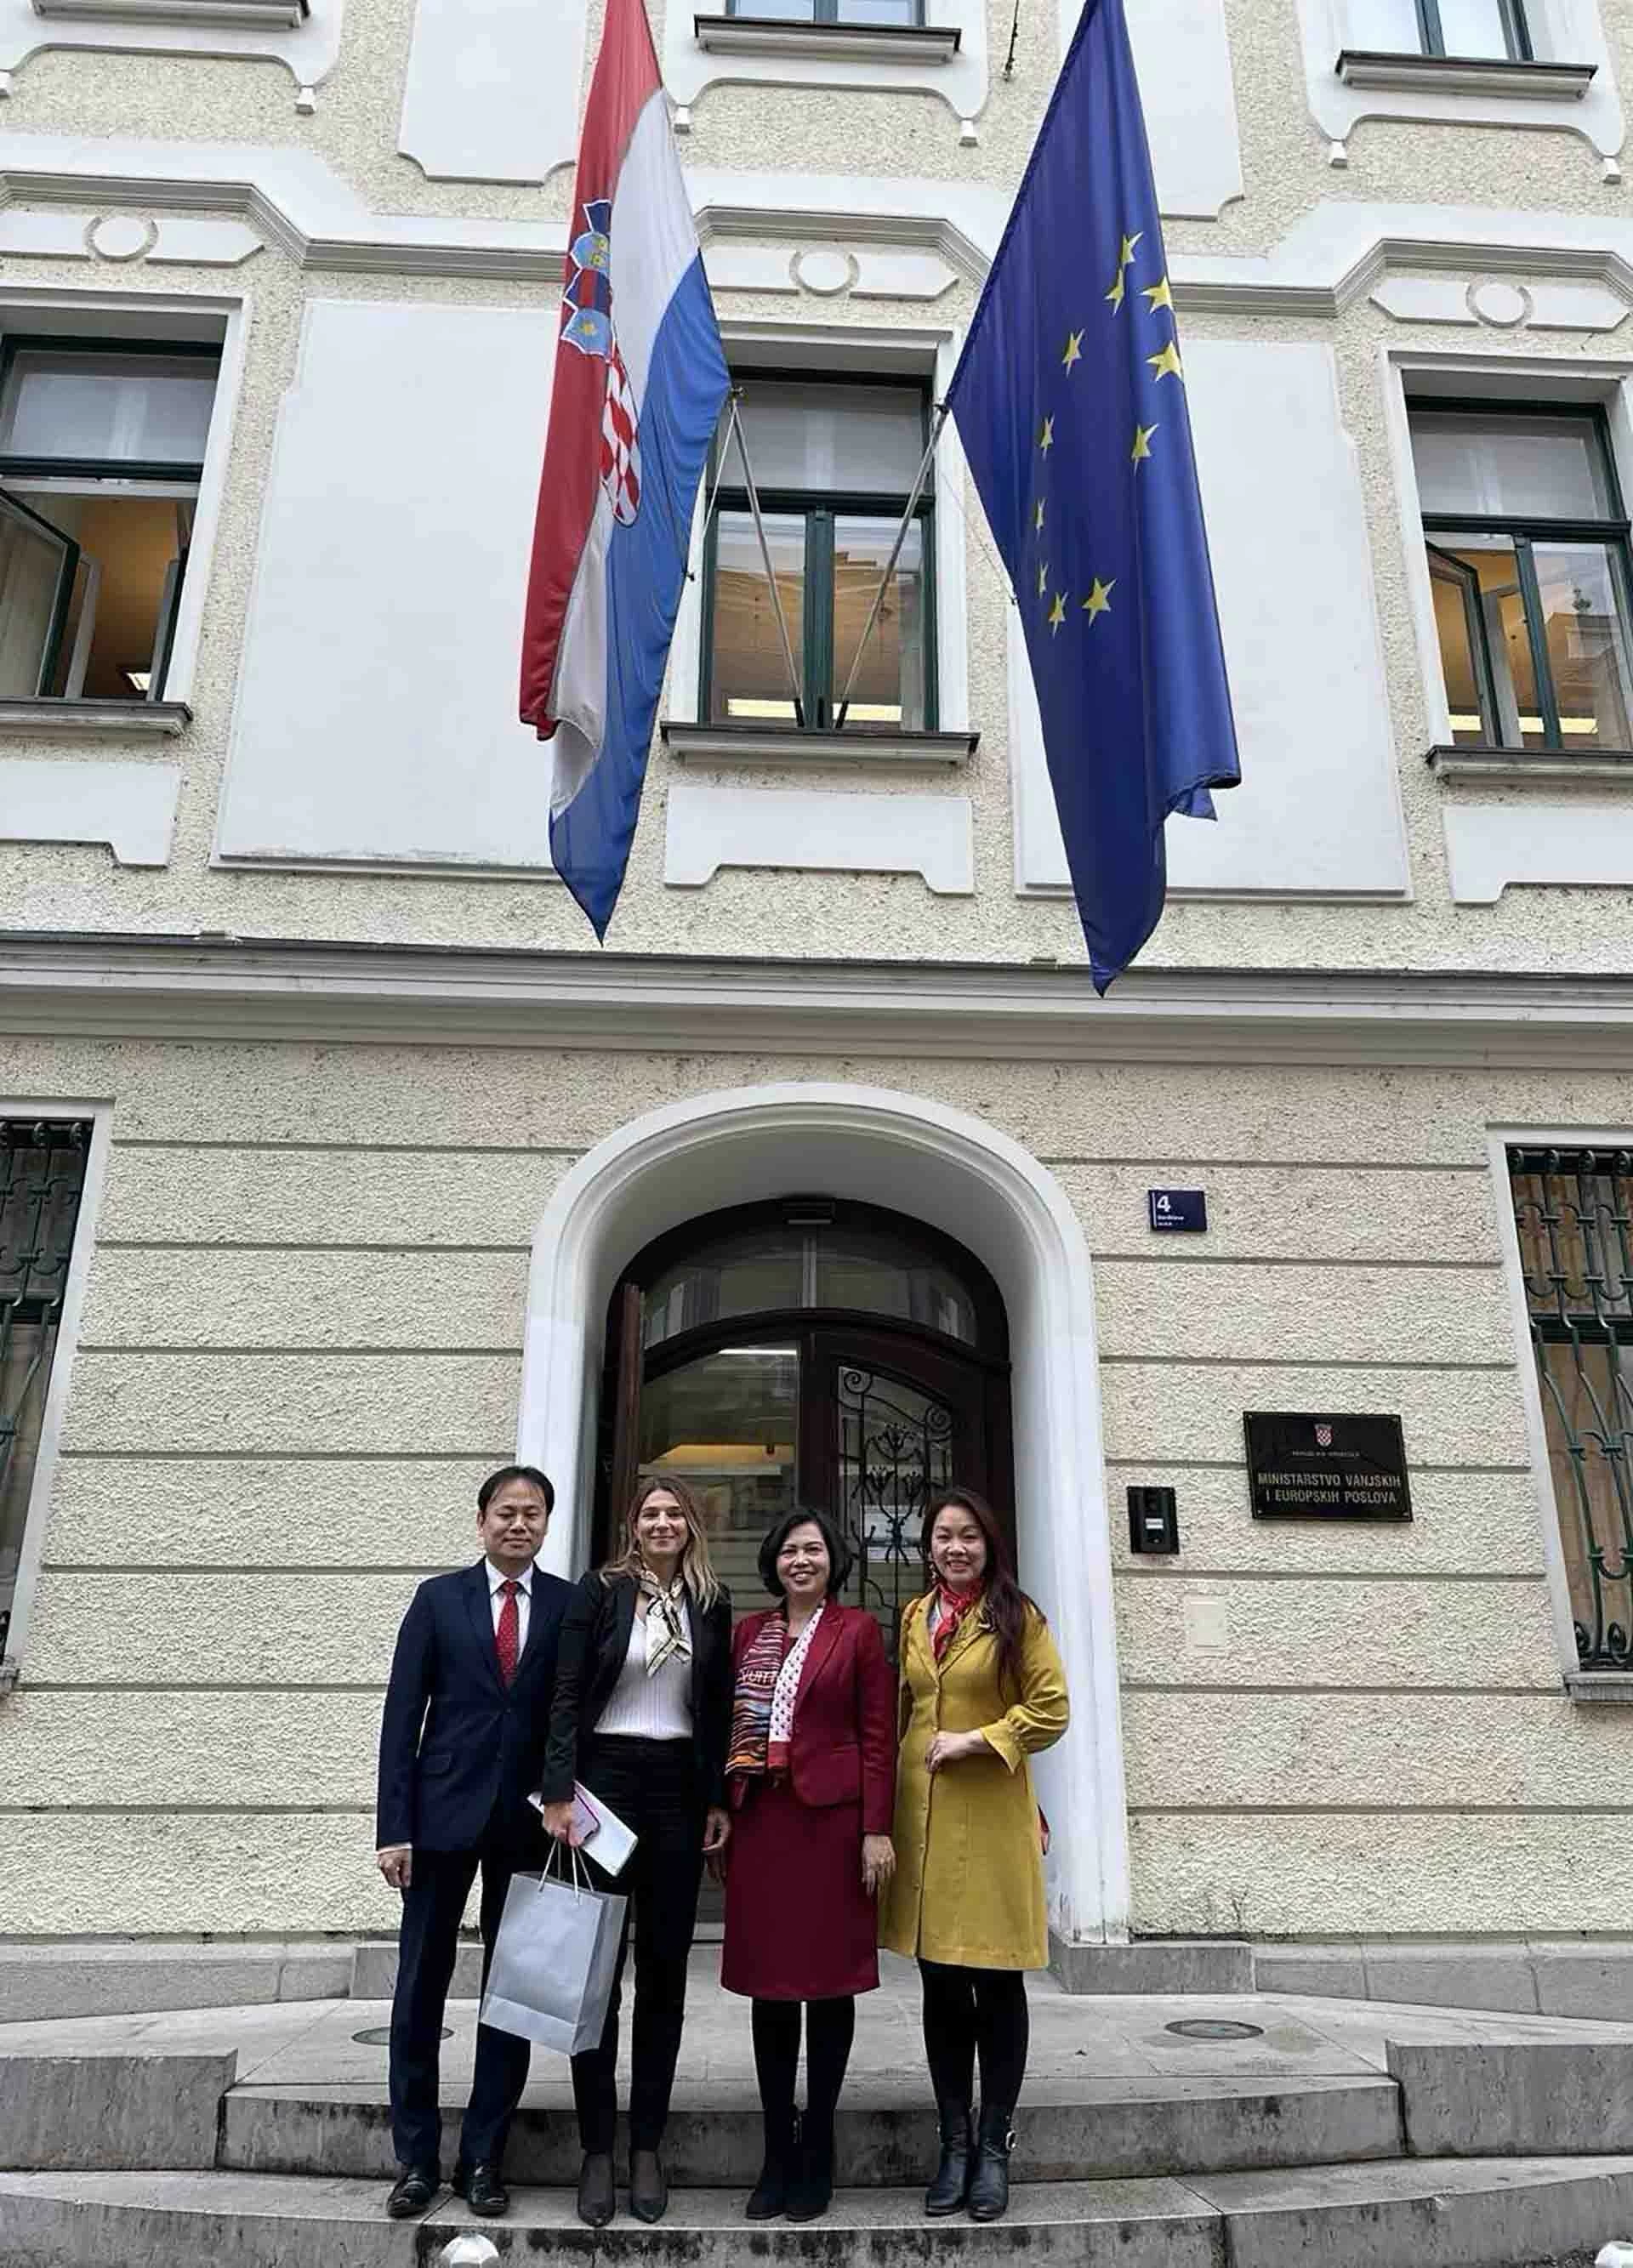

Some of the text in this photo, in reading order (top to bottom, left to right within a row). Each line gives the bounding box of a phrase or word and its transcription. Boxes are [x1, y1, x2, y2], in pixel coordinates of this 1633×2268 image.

[1157, 1195, 1171, 1213] 4
[1258, 1472, 1402, 1488] MINISTARSTVO VANJSKIH
[1266, 1489, 1397, 1504] I EUROPSKIH POSLOVA
